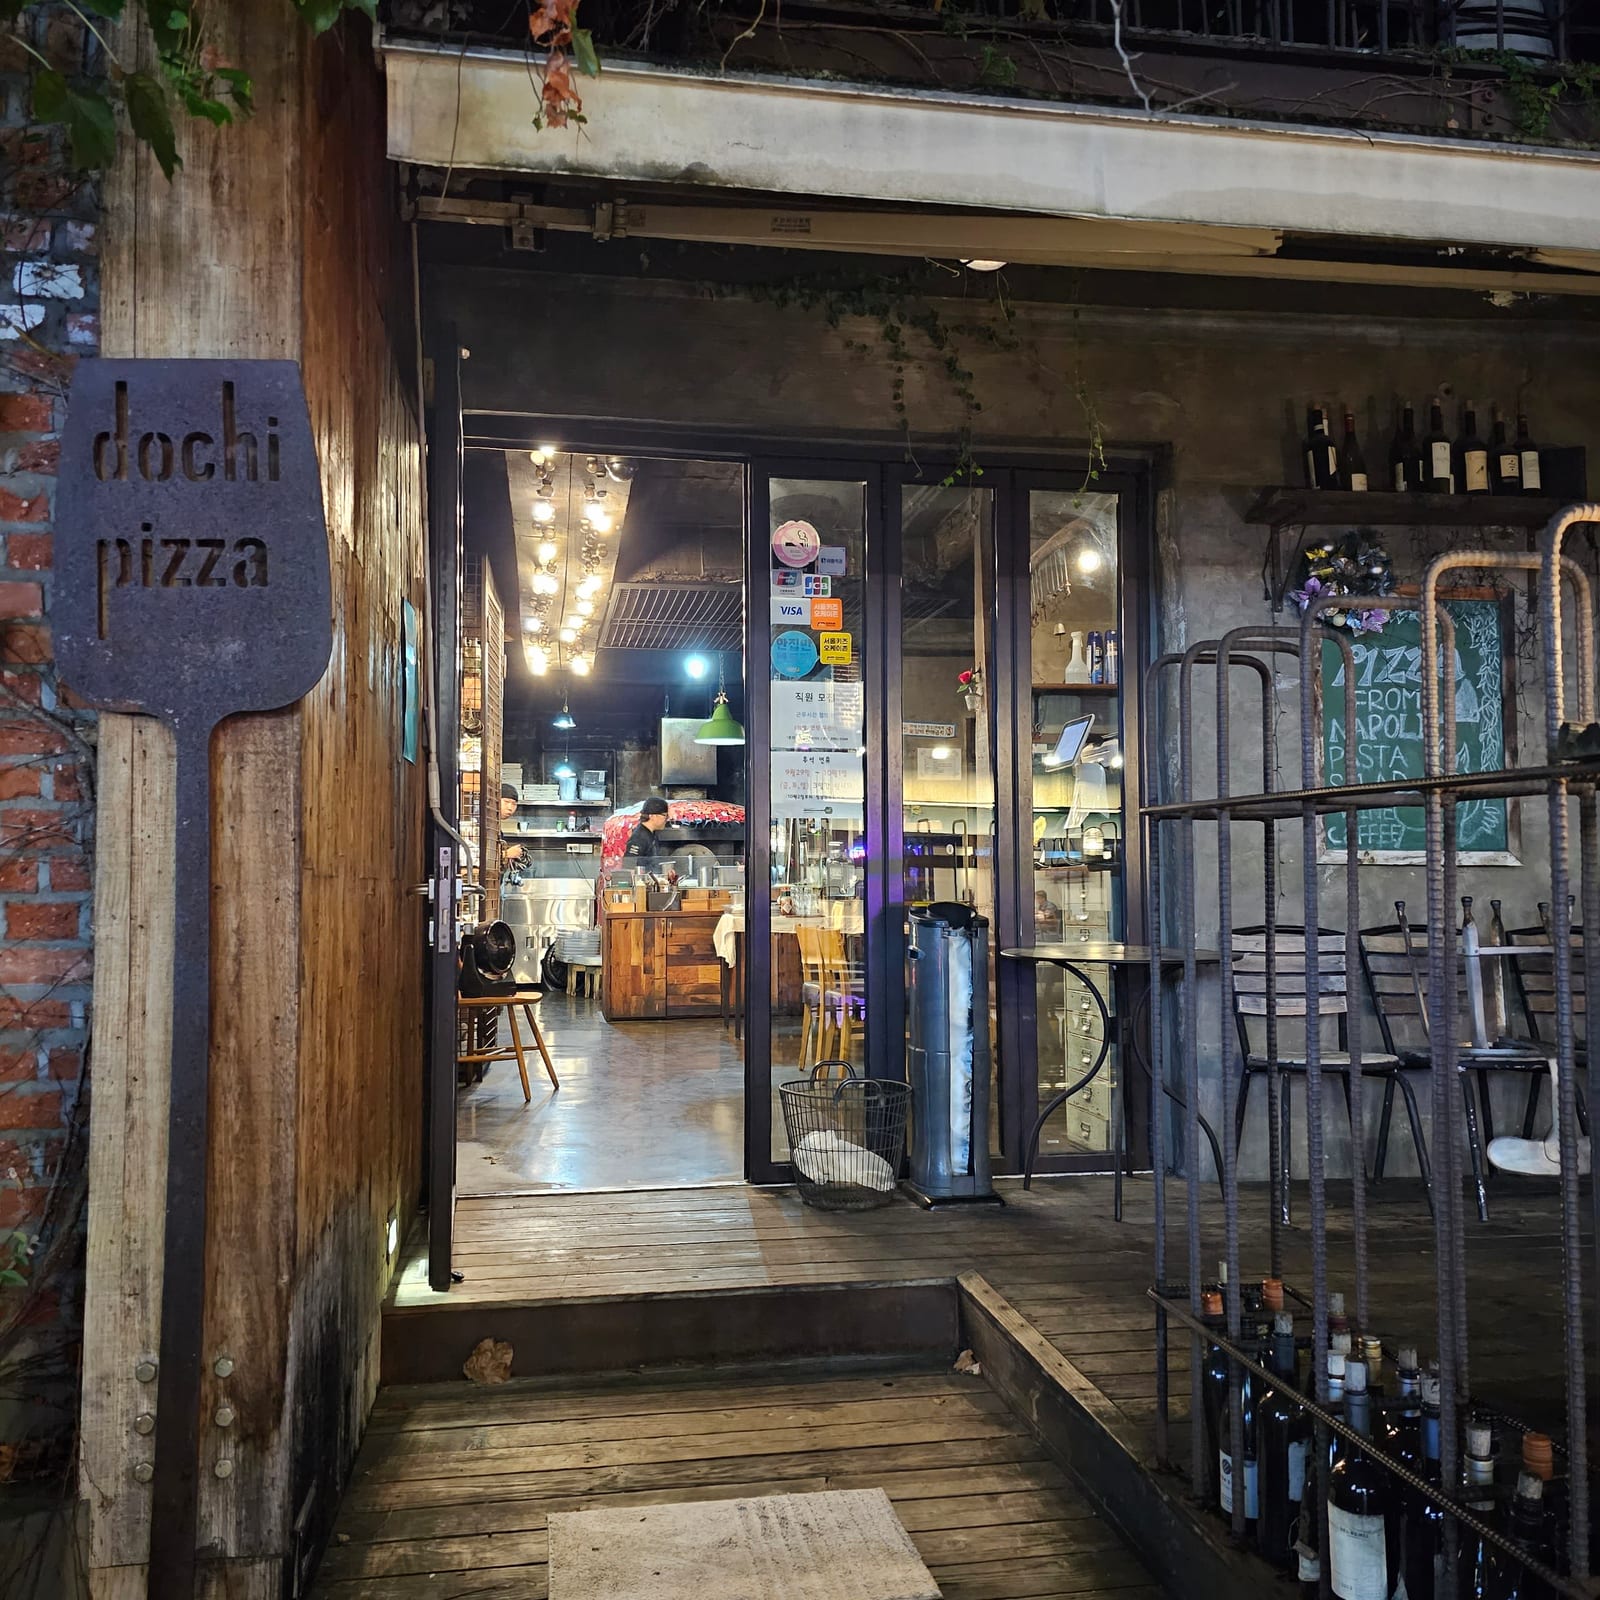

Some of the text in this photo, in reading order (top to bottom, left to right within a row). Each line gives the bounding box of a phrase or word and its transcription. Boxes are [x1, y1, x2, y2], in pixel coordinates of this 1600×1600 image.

[92, 380, 281, 482] dochi
[95, 522, 270, 640] pizza
[780, 605, 803, 616] VISA
[795, 692, 813, 703] 직원
[1354, 688, 1421, 712] FROM
[1329, 743, 1409, 771] PSTA
[1327, 823, 1402, 846] CFFEE
